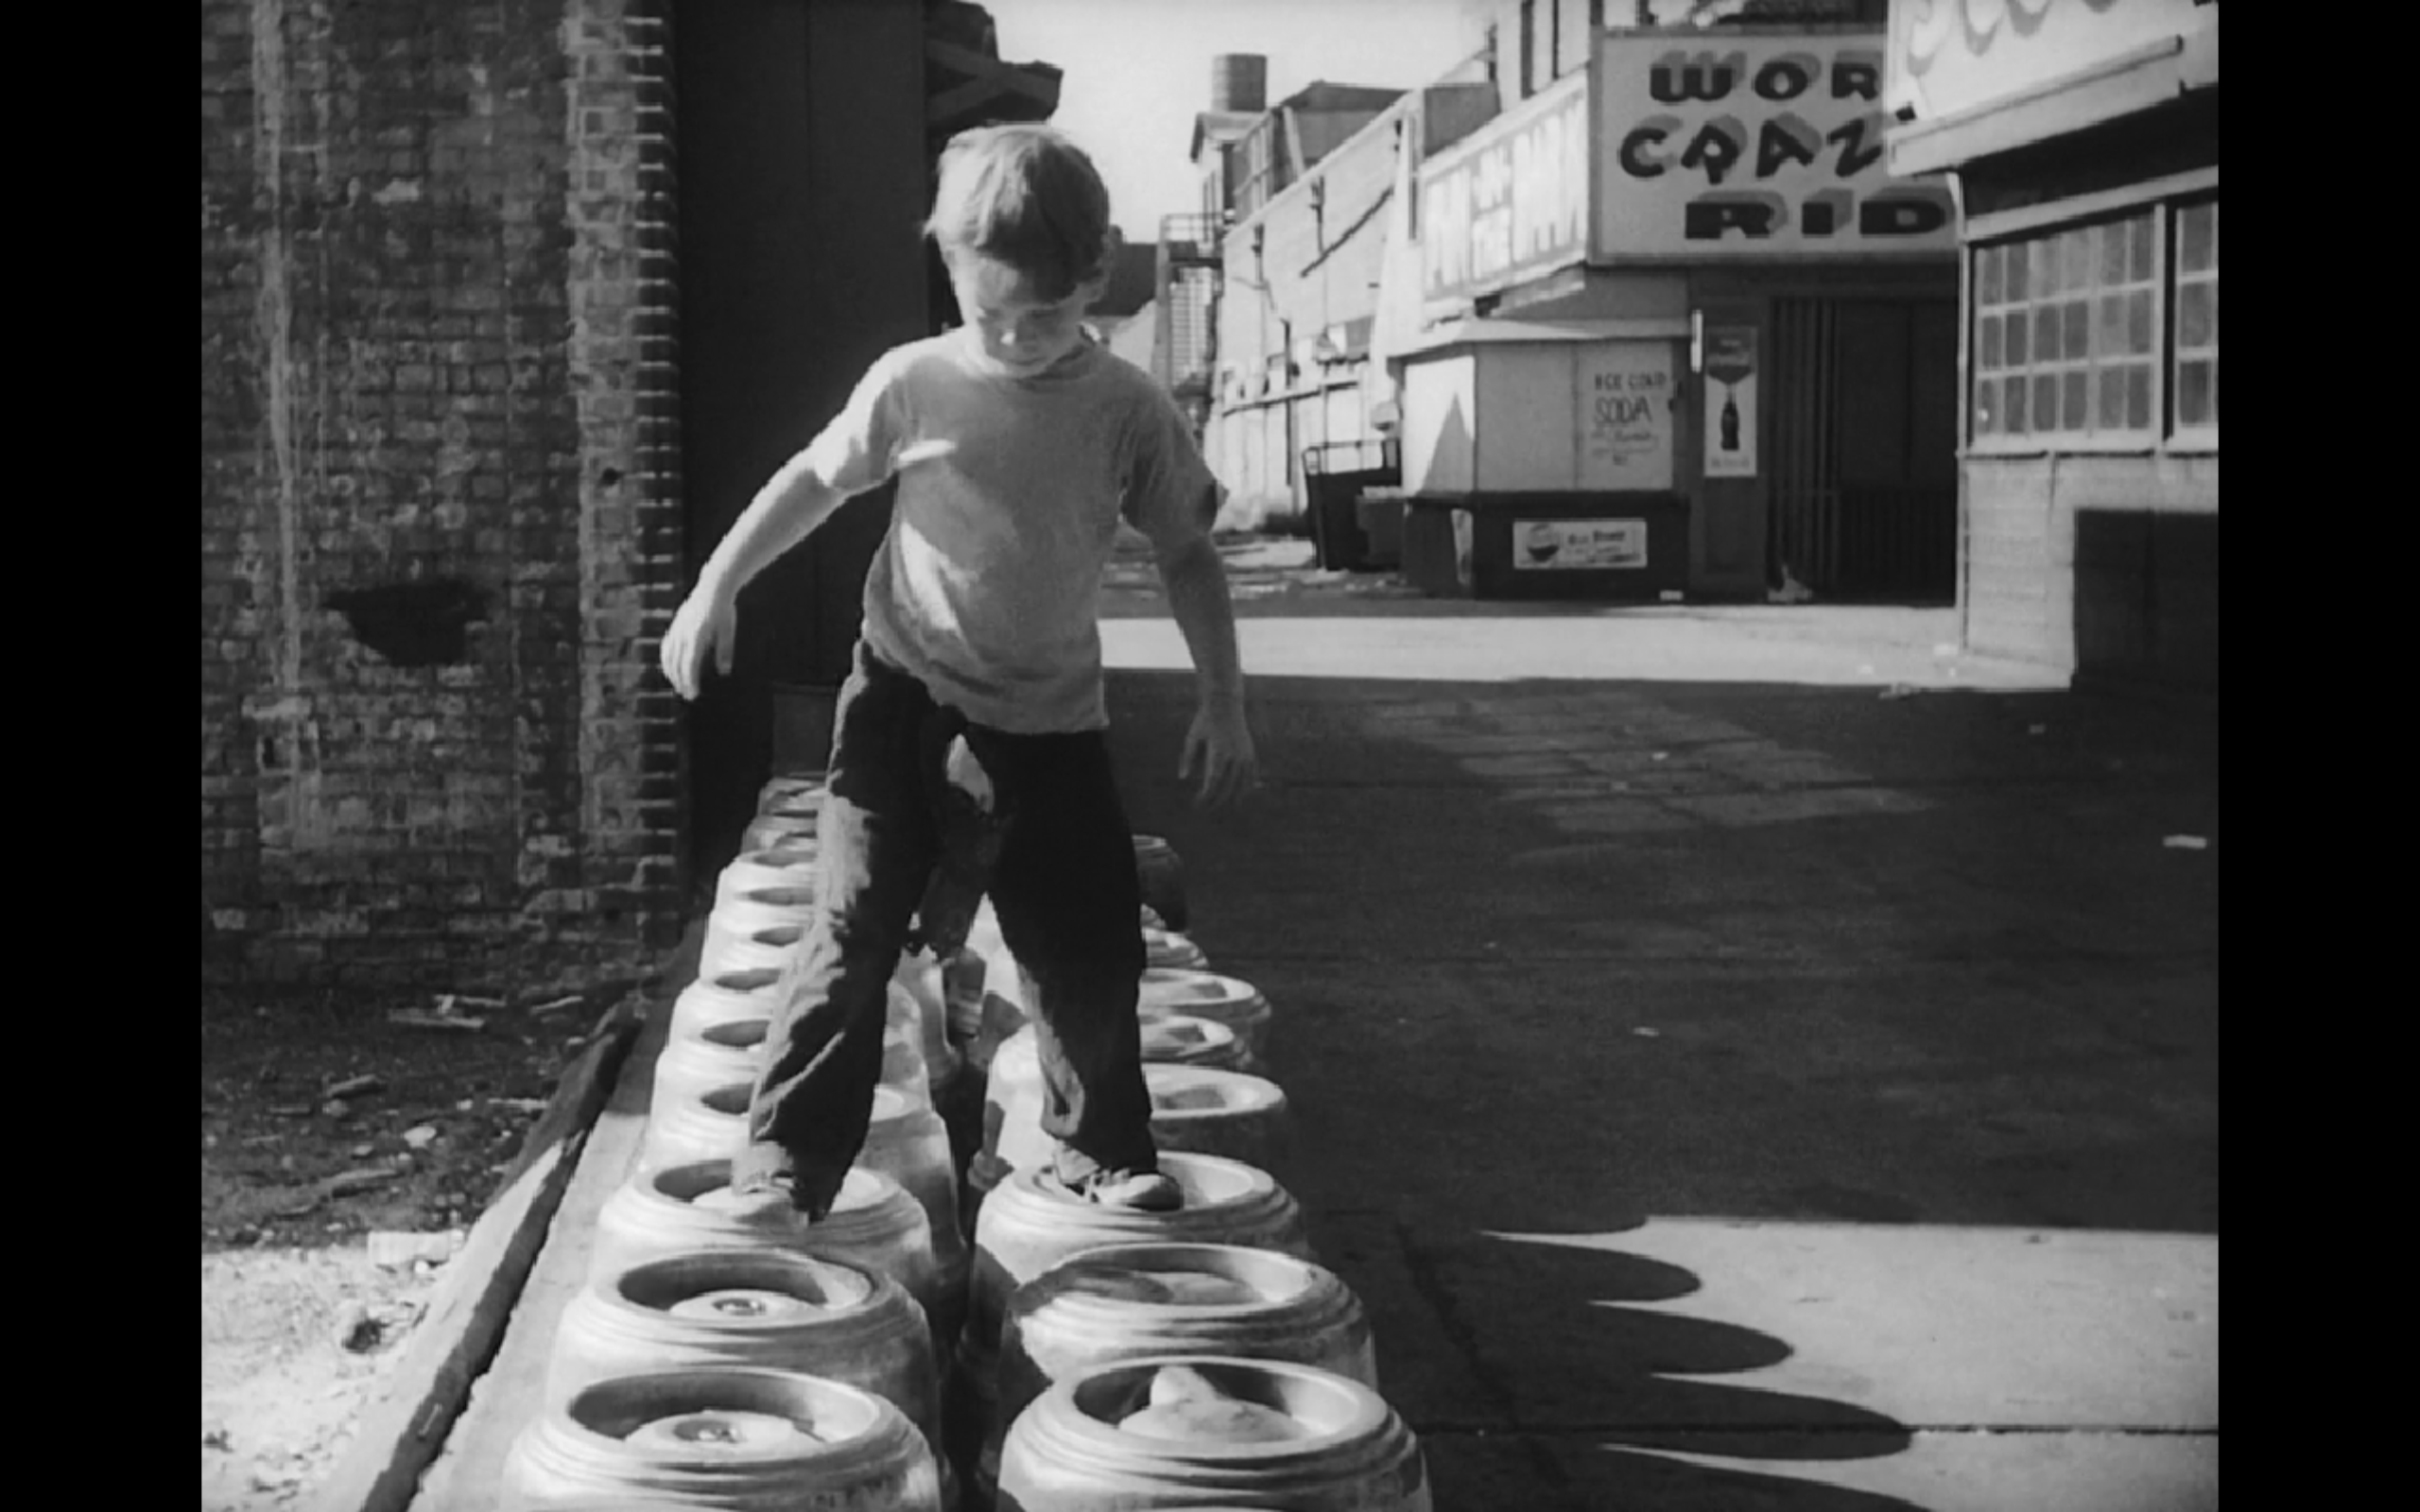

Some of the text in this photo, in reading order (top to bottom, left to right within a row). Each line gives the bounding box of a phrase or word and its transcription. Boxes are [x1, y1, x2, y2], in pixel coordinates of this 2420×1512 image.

[1650, 54, 1881, 103] WOR
[1619, 115, 1883, 185] CRAZ
[1685, 195, 1949, 238] RID
[1594, 396, 1653, 425] SODA
